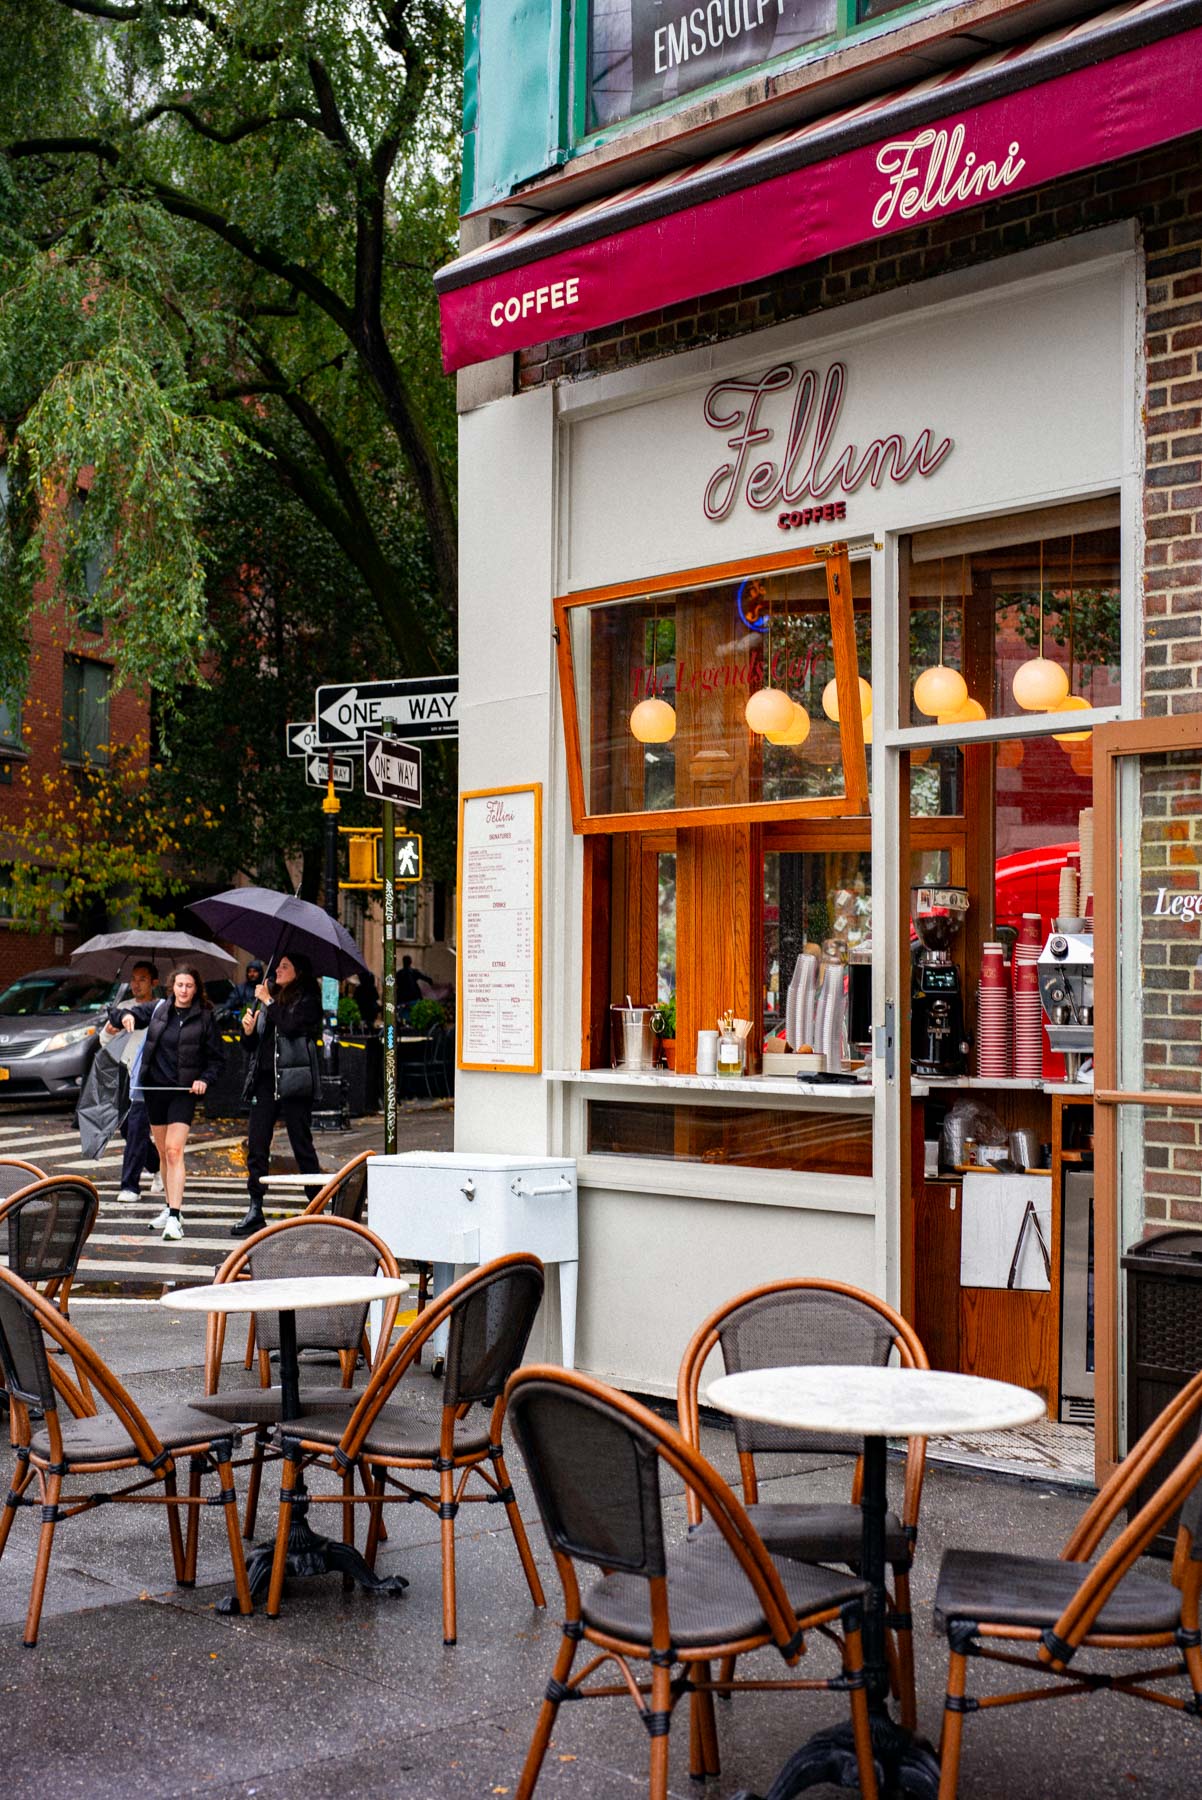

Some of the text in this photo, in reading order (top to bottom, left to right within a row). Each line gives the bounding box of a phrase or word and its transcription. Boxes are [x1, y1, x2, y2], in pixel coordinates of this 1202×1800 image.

[872, 123, 1026, 228] Fellini
[490, 277, 580, 328] COFFEE
[703, 362, 953, 520] Fellini
[777, 501, 847, 529] COFFEE
[630, 664, 670, 698] The
[674, 648, 766, 693] Legends
[338, 695, 457, 725] ONE WAY
[333, 767, 348, 780] WAY
[375, 755, 415, 787] ONE WAY
[486, 800, 515, 823] Fellini
